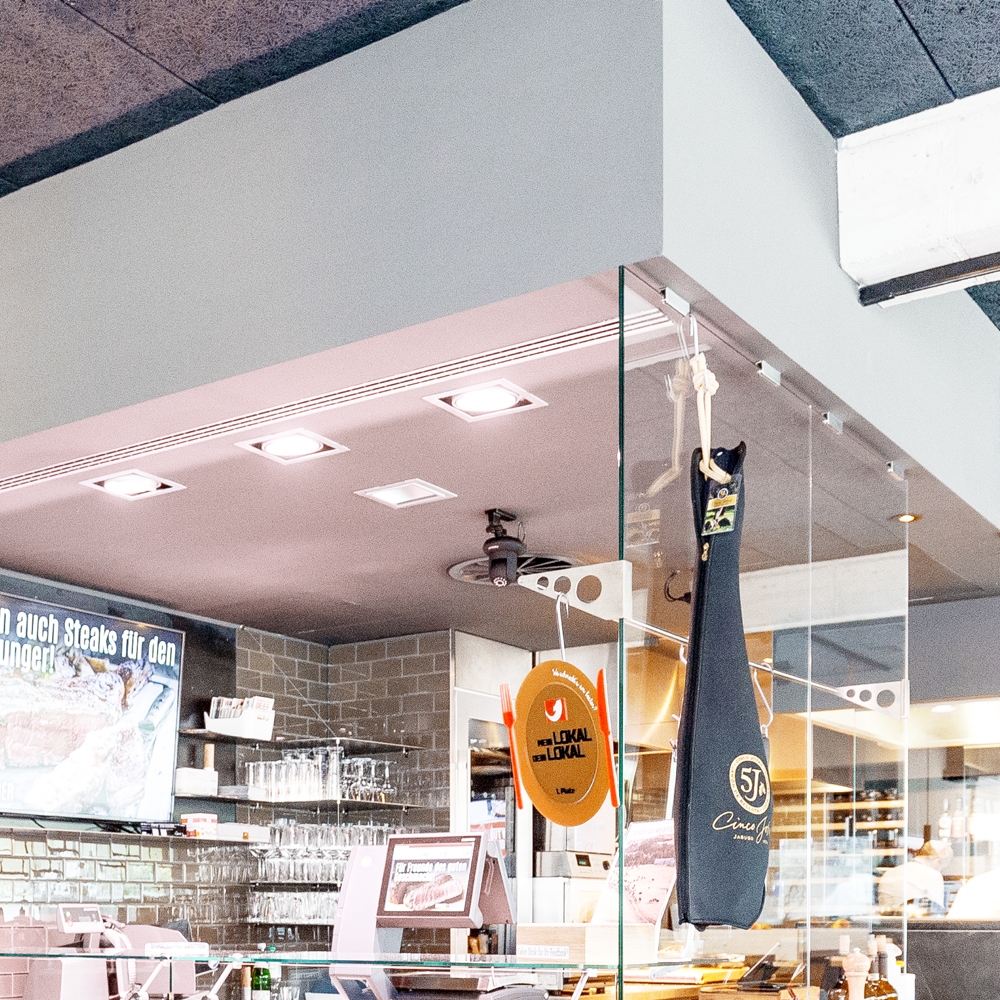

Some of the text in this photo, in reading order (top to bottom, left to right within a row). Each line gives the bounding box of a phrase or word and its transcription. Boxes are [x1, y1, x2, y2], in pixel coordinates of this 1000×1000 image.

[17, 611, 59, 644] auch
[64, 617, 117, 656] Steaks
[121, 629, 146, 660] für
[149, 635, 176, 667] den
[537, 727, 593, 747] MEIN LOKAL
[532, 743, 586, 762] DEIN LOKAL
[712, 811, 755, 831] Cinco
